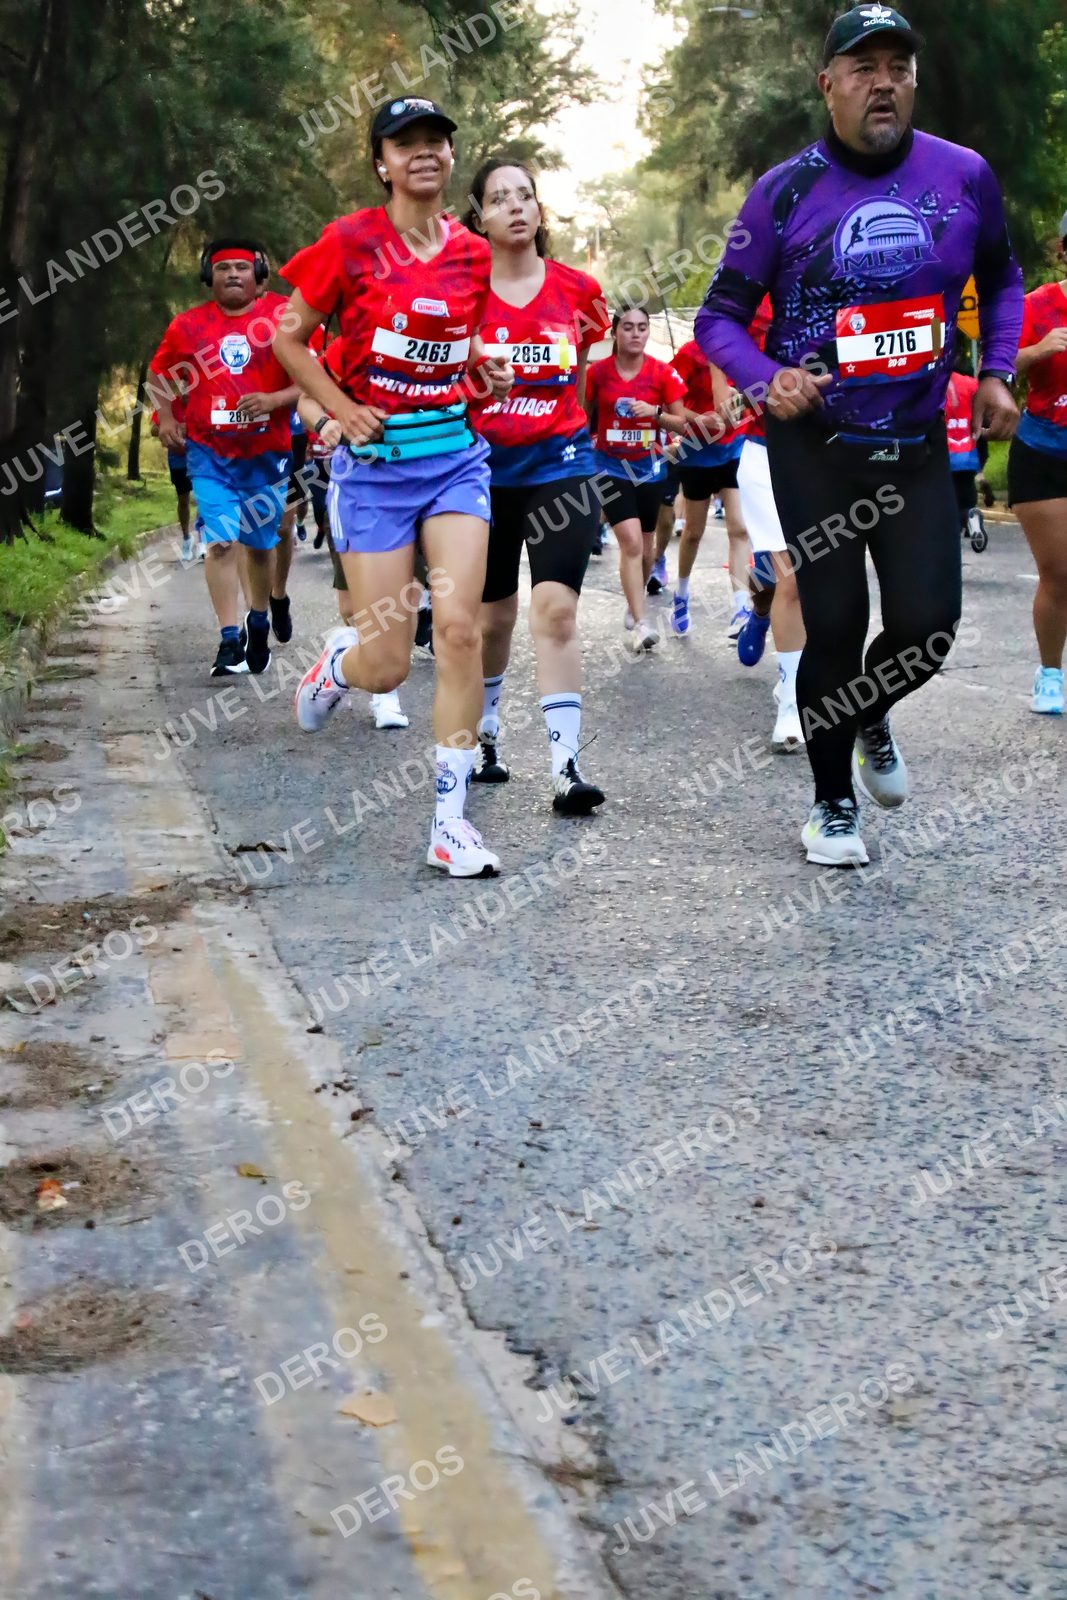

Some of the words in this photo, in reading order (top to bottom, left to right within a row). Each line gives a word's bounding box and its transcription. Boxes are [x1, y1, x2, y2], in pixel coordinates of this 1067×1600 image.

[863, 17, 896, 27] adidas
[843, 245, 929, 274] MRT
[405, 340, 451, 363] 2463
[874, 330, 917, 356] 2716
[512, 345, 551, 363] 2854
[621, 430, 642, 441] 2310
